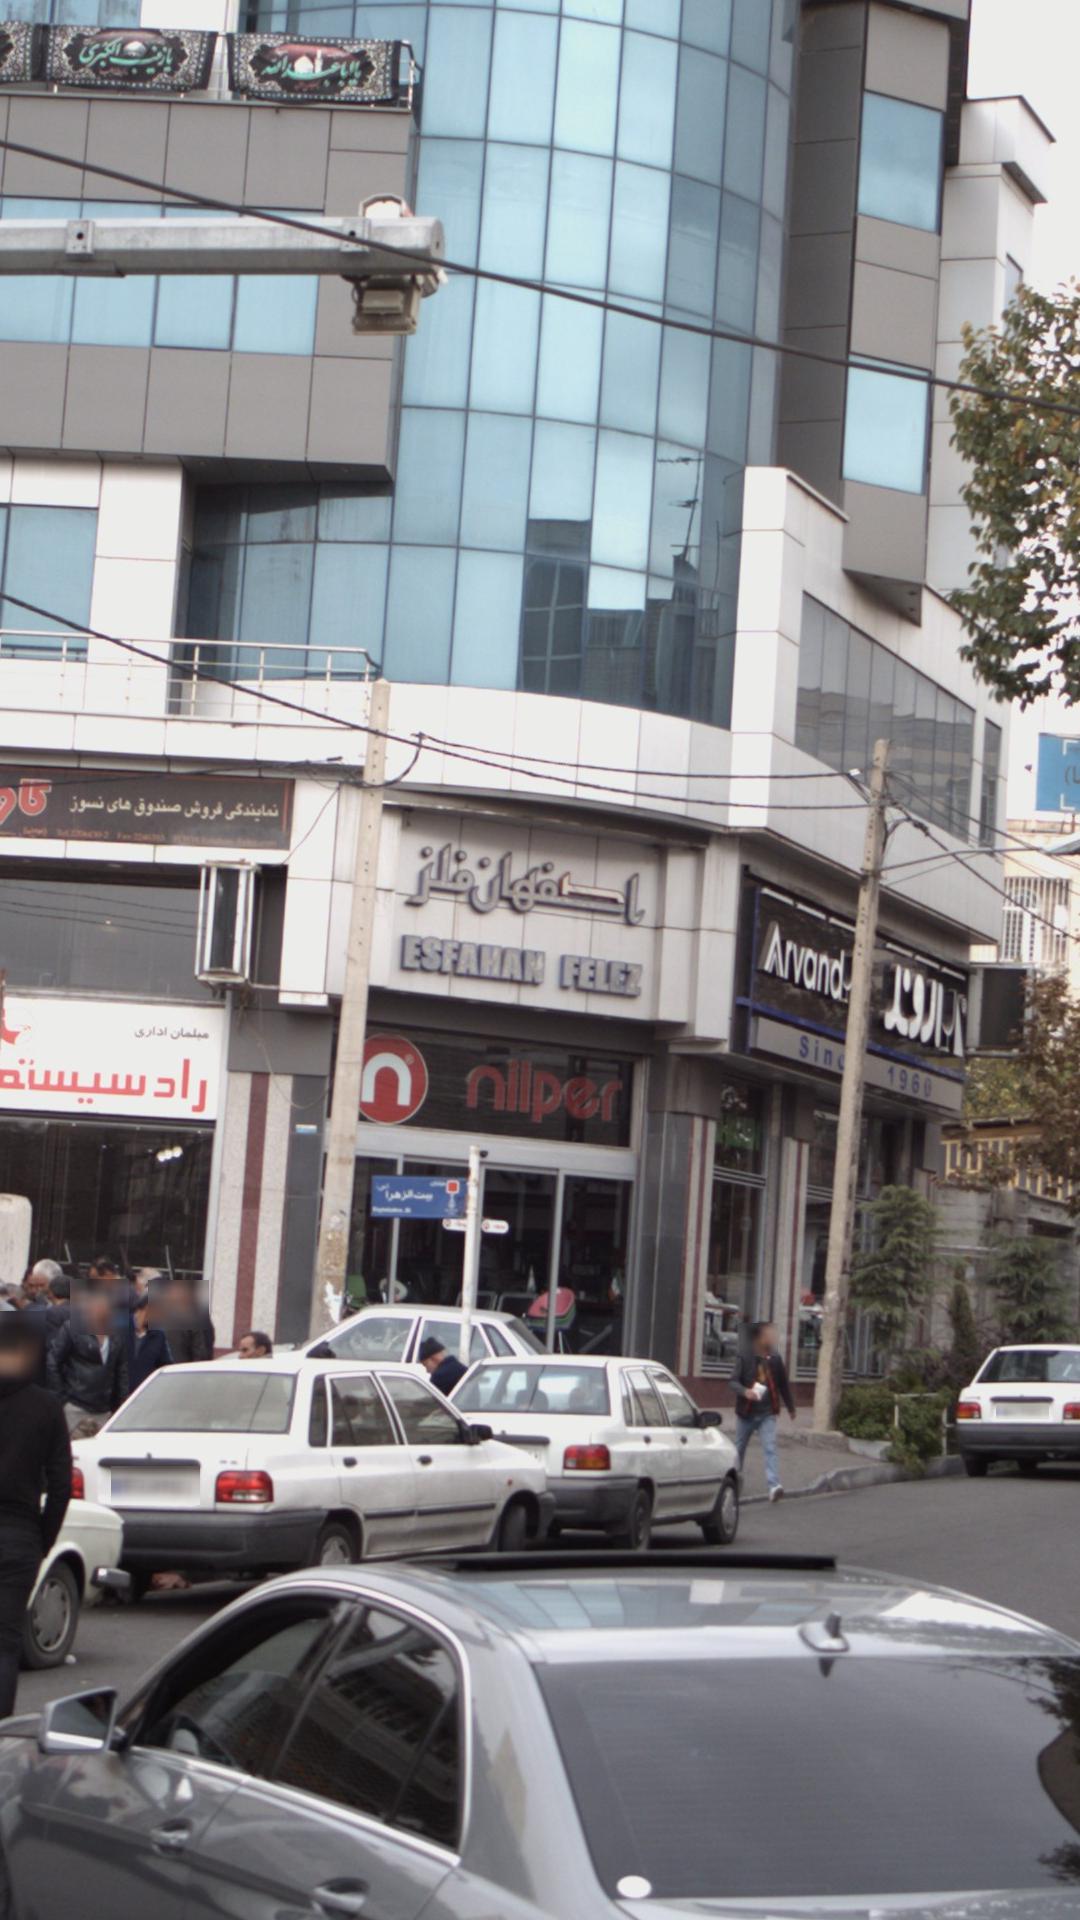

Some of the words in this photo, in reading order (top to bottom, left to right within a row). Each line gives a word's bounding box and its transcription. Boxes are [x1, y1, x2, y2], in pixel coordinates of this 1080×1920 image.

[69, 796, 104, 813] نسوز
[107, 797, 131, 813] های
[134, 799, 182, 816] صندوق
[184, 801, 223, 820] فروش
[225, 803, 279, 822] نمایندگی
[401, 934, 546, 985] ESFAHAN
[560, 954, 643, 998] FELEZ
[764, 925, 848, 1001] Arvand
[134, 1026, 167, 1038] اداری
[170, 1027, 209, 1042] مبلمان
[799, 1035, 845, 1072] Sinc
[888, 1065, 933, 1098] 1960
[153, 1058, 207, 1113] راد
[466, 1058, 623, 1123] nilper
